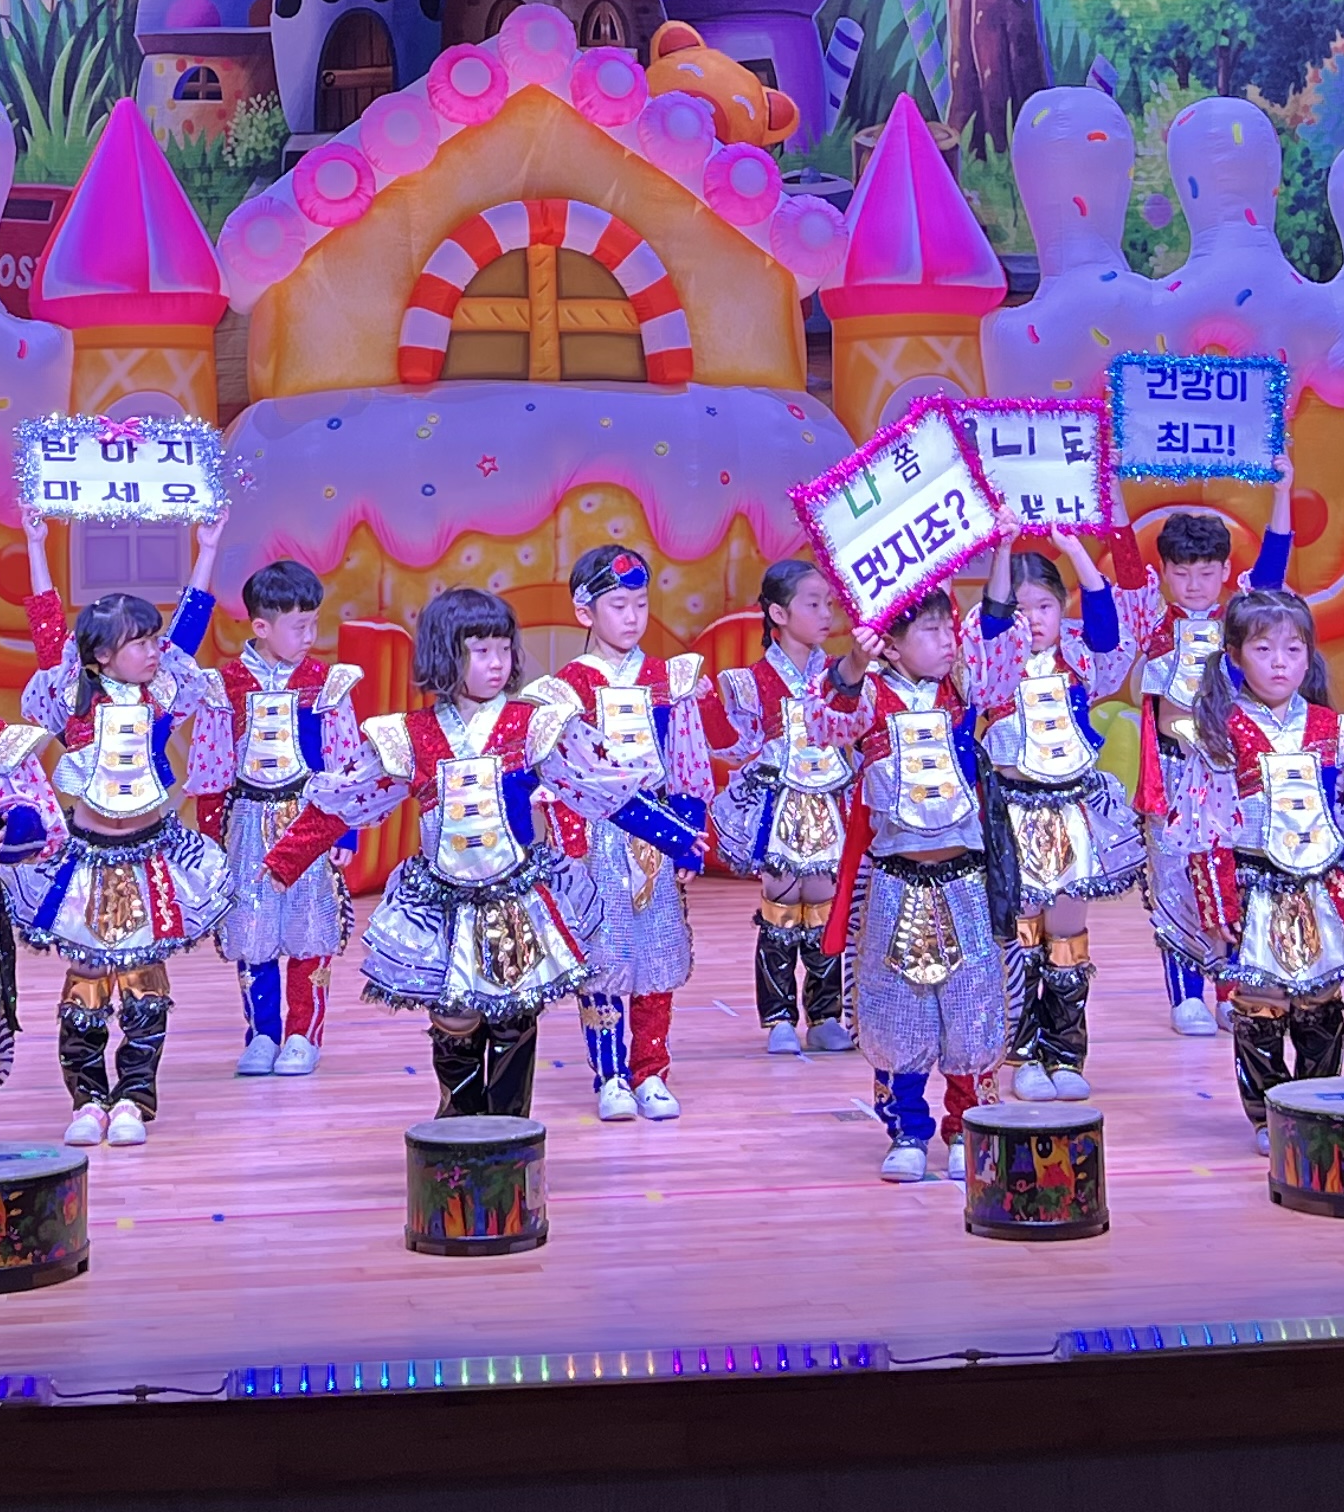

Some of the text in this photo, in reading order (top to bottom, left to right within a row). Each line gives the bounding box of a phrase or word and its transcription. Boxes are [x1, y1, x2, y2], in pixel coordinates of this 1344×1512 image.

[1146, 367, 1247, 402] 건강이
[1156, 421, 1236, 457] 최고!
[42, 480, 200, 503] 마세요
[850, 488, 970, 600] 멋지죠?
